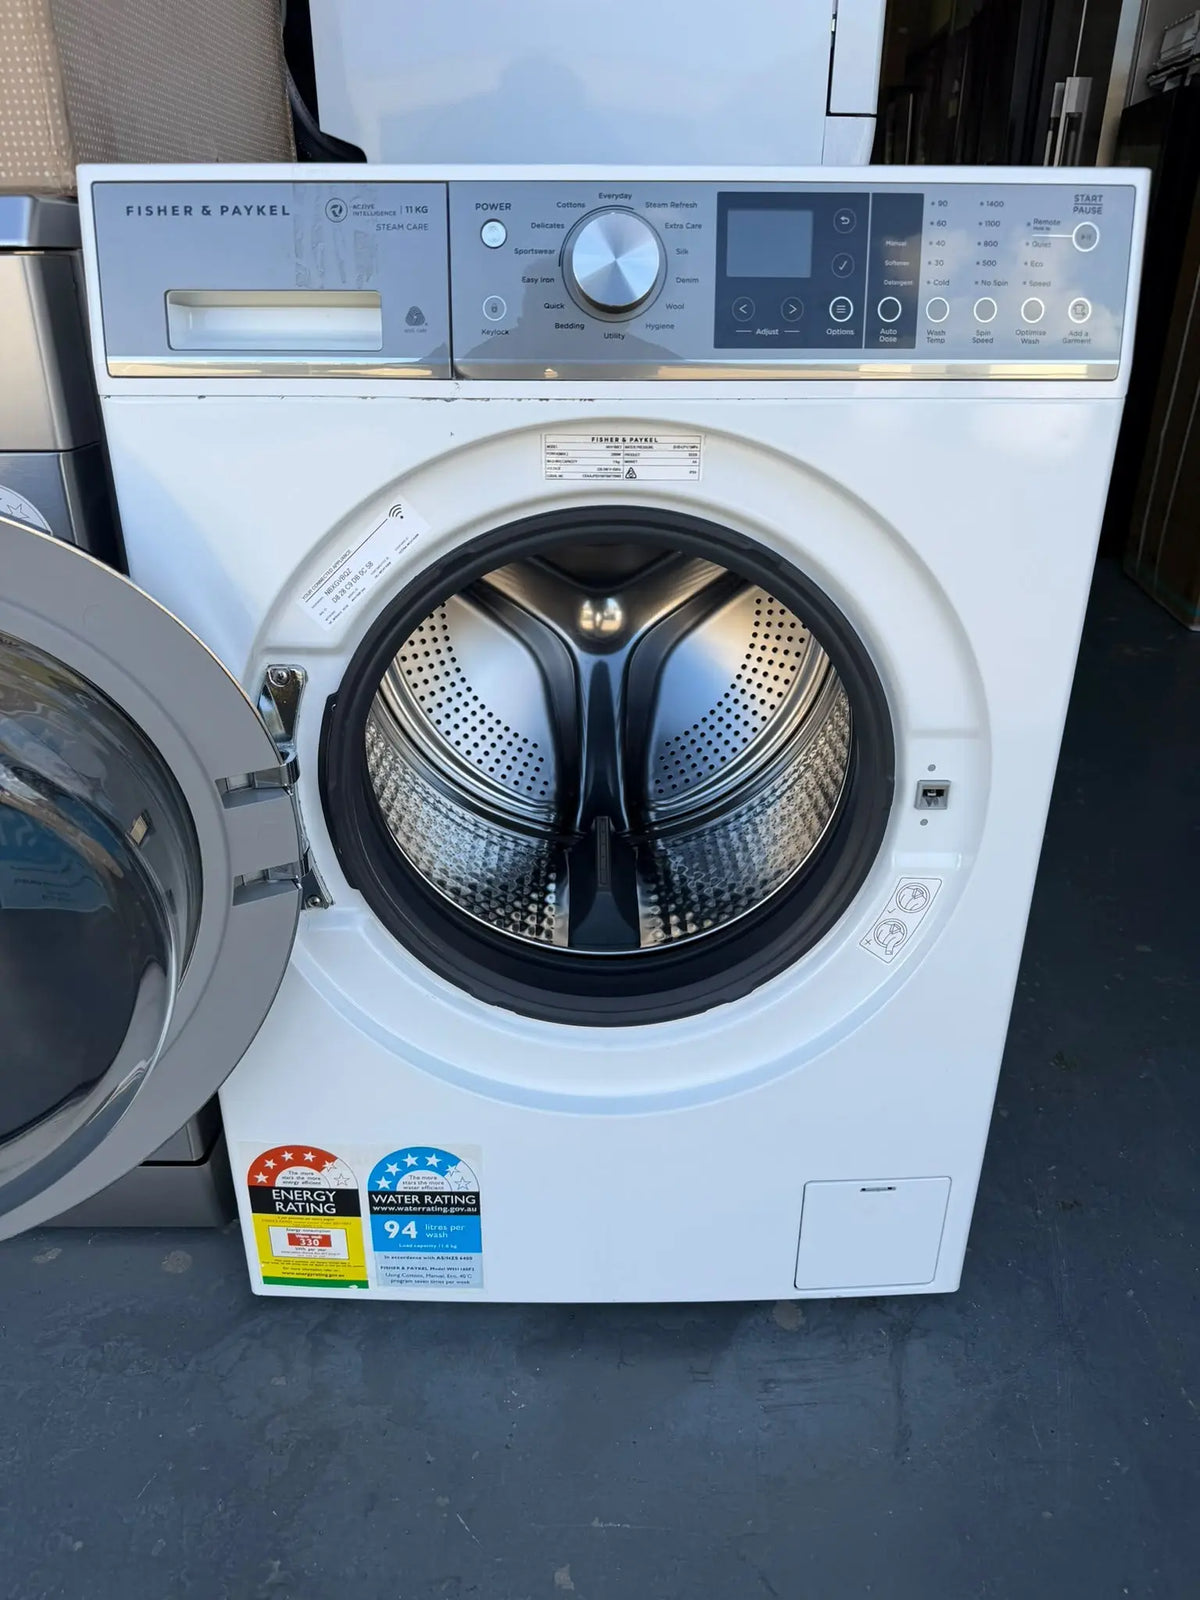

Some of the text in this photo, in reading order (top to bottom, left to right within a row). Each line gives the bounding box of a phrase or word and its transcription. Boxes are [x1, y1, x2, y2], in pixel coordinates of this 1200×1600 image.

[598, 192, 632, 200] Everyday
[126, 205, 291, 216] FISHER & PAYKEL
[406, 206, 414, 214] 11
[415, 205, 428, 214] KG
[475, 202, 512, 211] POWER
[1072, 206, 1102, 214] PAUSE
[376, 223, 428, 231] STEAM CARE
[554, 322, 585, 330] Bedding
[646, 322, 675, 330] Hygiene
[272, 1189, 337, 1202] ENERGY
[372, 1194, 476, 1204] WATER RATING
[276, 1202, 337, 1214] RATING
[384, 1220, 418, 1239] 94
